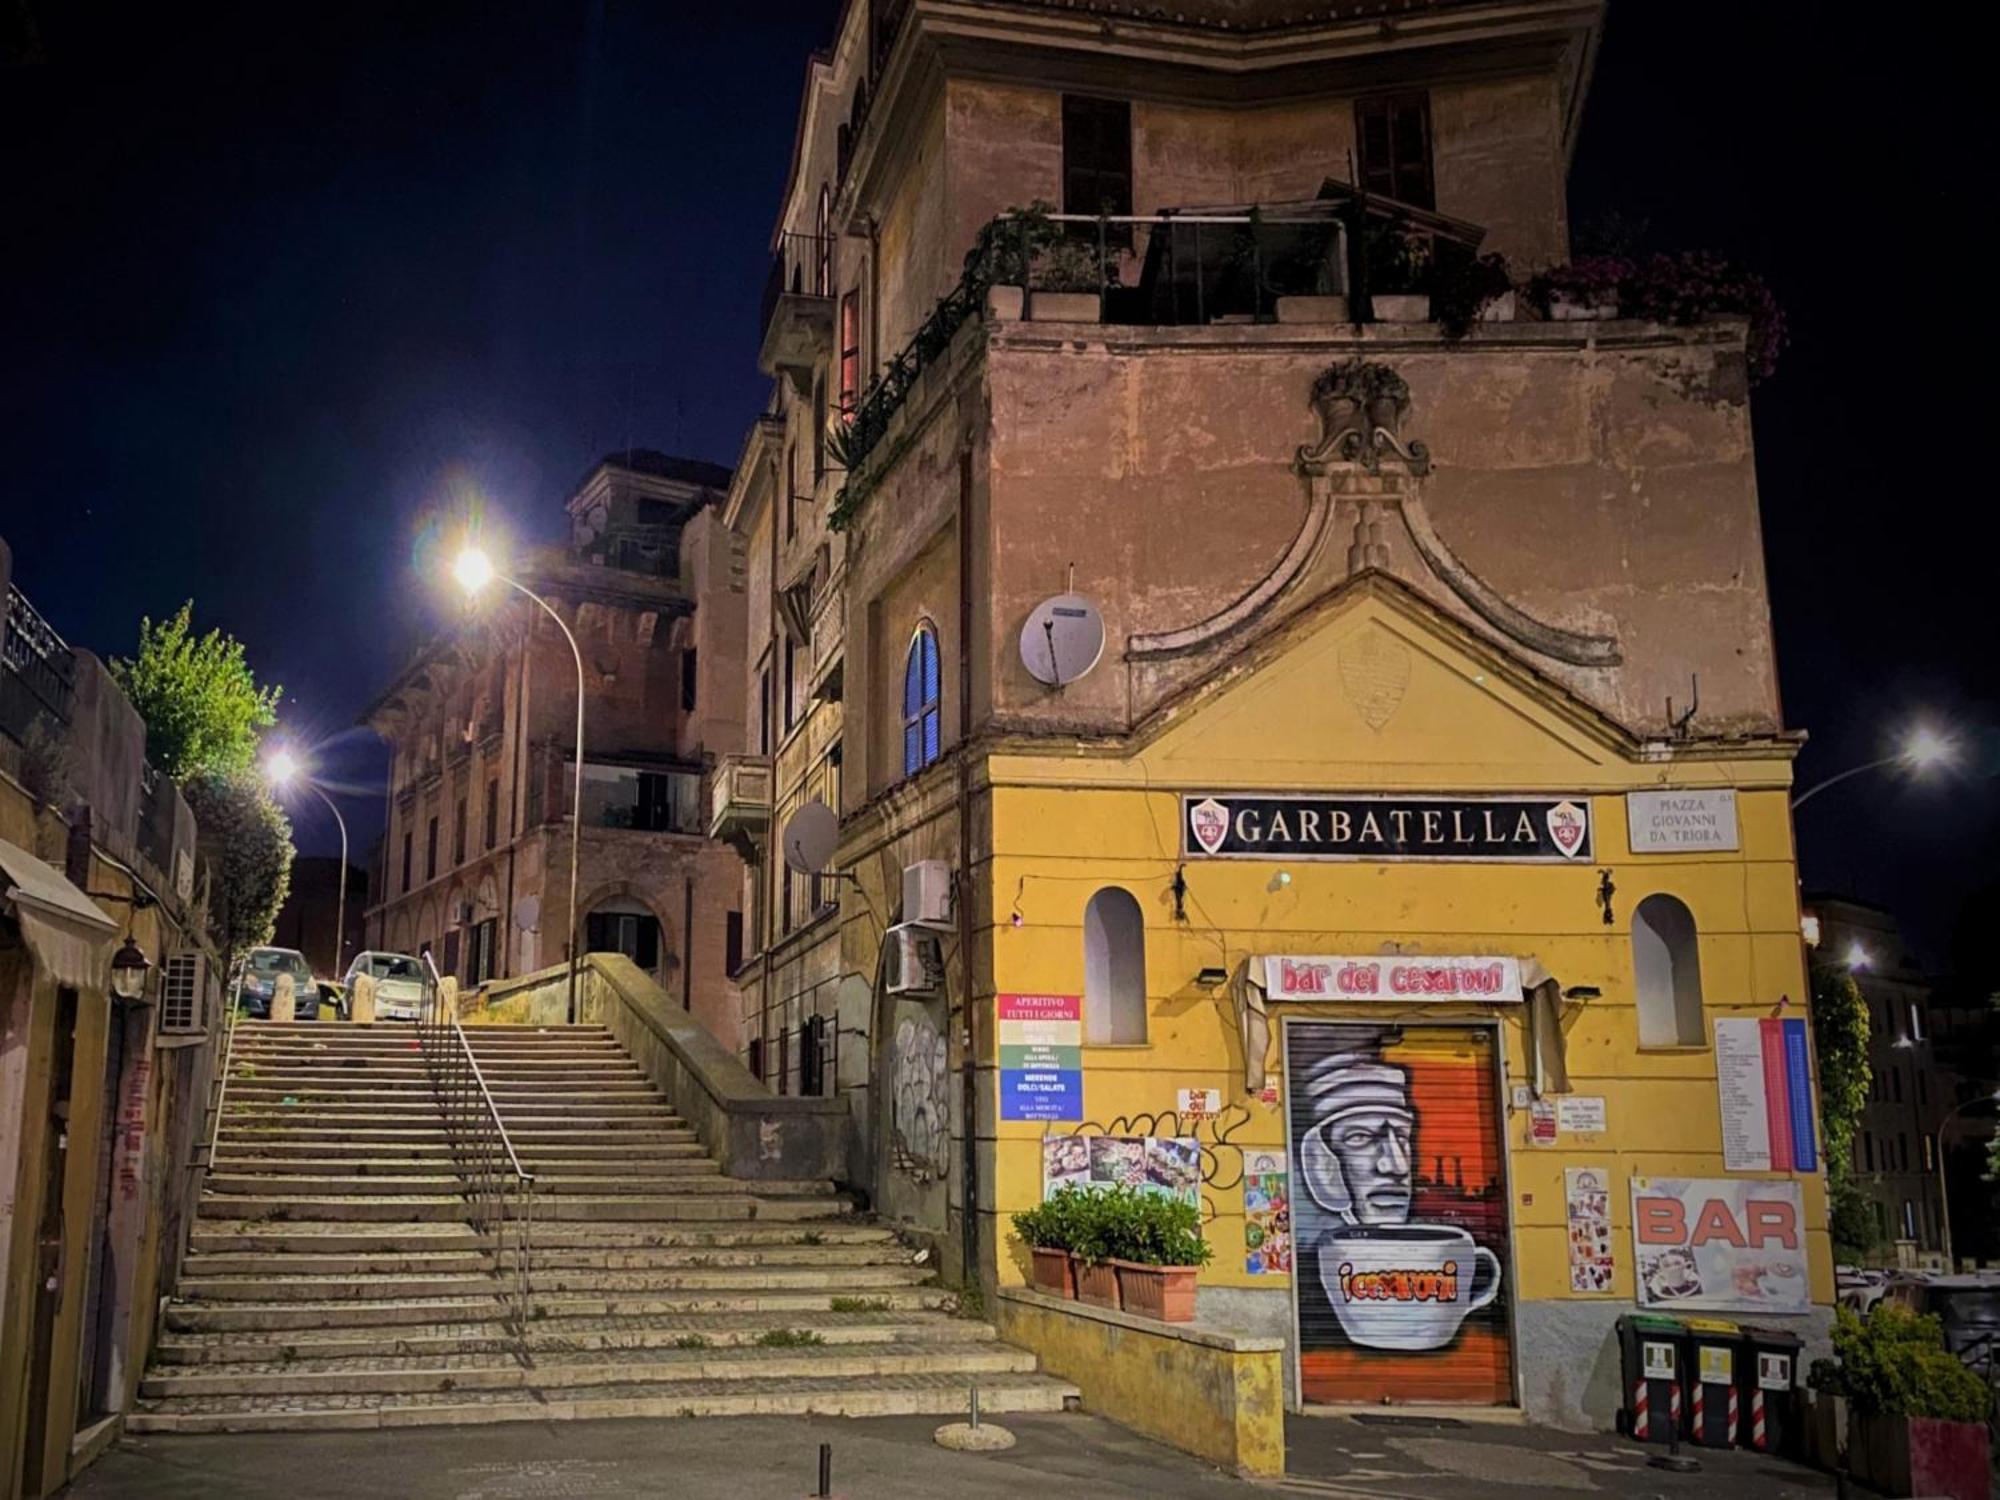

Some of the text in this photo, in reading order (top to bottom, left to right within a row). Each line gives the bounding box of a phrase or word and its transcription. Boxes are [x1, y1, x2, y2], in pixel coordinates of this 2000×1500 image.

[1660, 799, 1705, 812] PIAZZA
[1235, 808, 1538, 844] GARBATELLA
[1652, 814, 1716, 828] GIOVANNI
[1649, 829, 1723, 843] DA TRIORA
[1281, 958, 1504, 995] bar dei cesaroni
[1015, 997, 1065, 1007] APERITIVO
[1007, 1010, 1031, 1018] TUTTI
[1040, 1010, 1073, 1019] GIORNI
[1636, 1196, 1798, 1249] BAR
